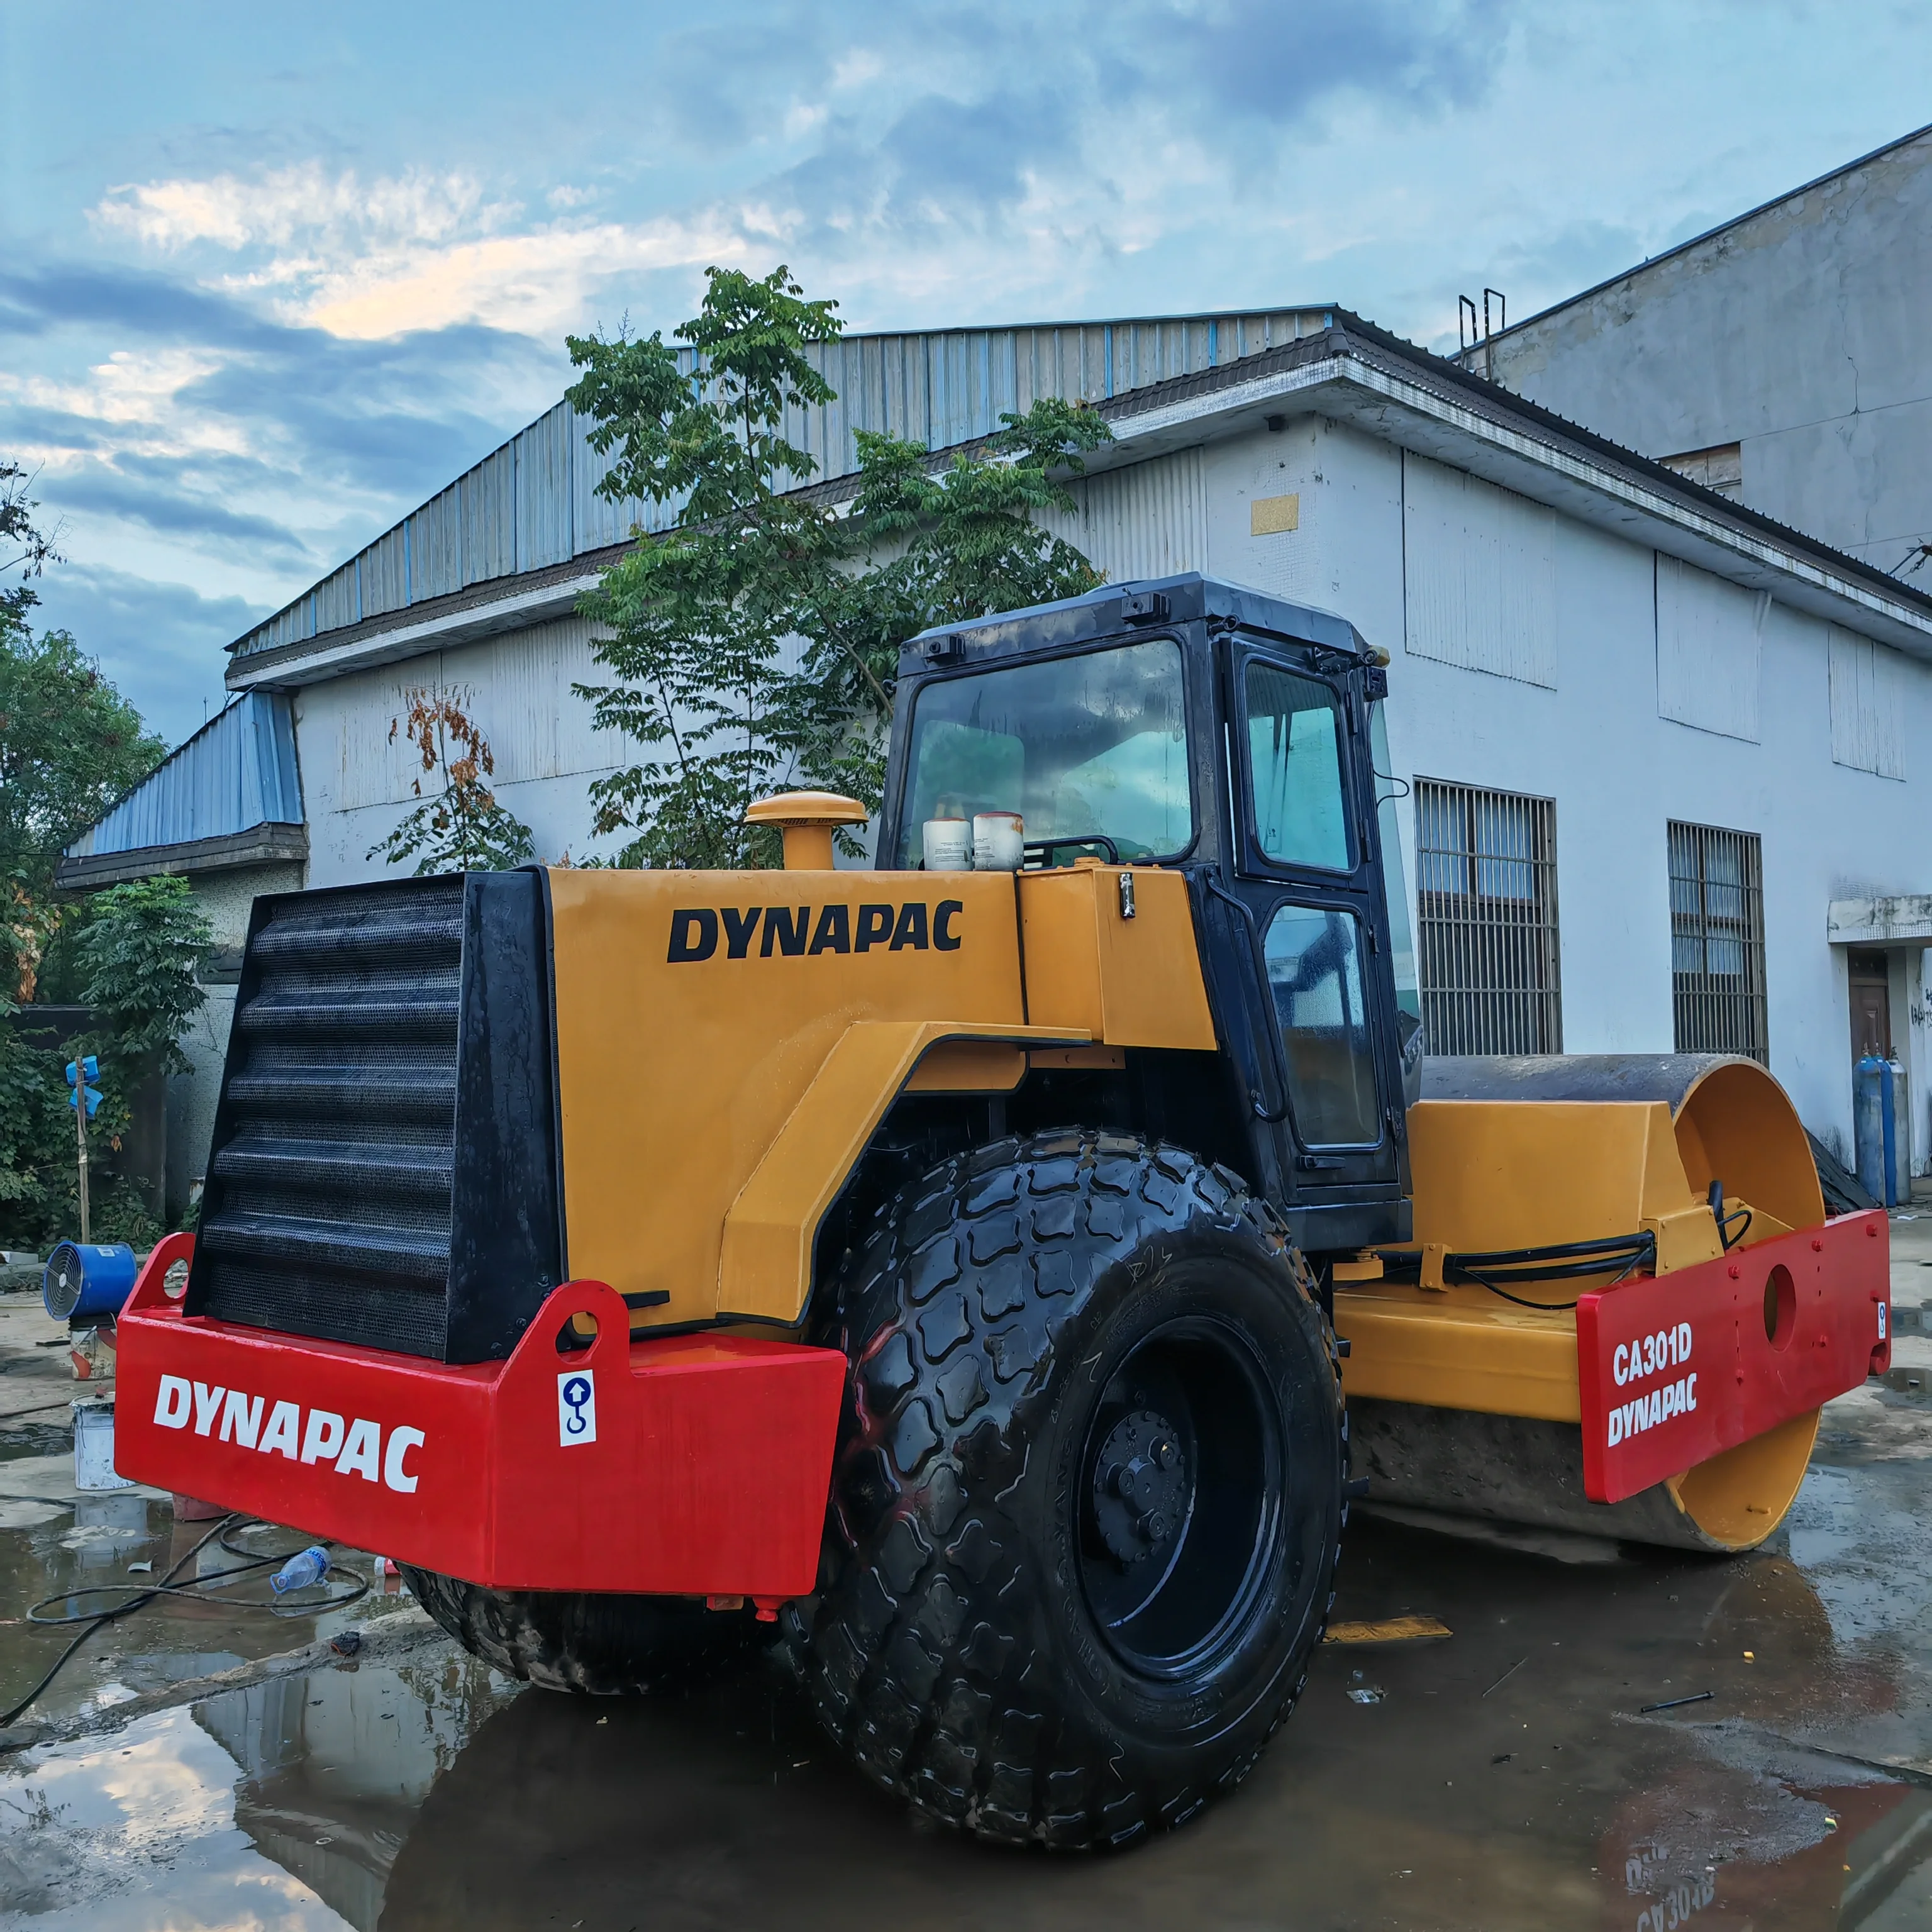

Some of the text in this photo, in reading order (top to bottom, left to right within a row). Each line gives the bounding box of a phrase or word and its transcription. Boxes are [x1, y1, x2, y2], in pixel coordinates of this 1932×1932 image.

[667, 899, 963, 963] DYNAPAC
[1613, 1322, 1692, 1386] CA301D
[153, 1374, 426, 1493] DYNAPAC
[1607, 1372, 1697, 1448] DYNAPAC
